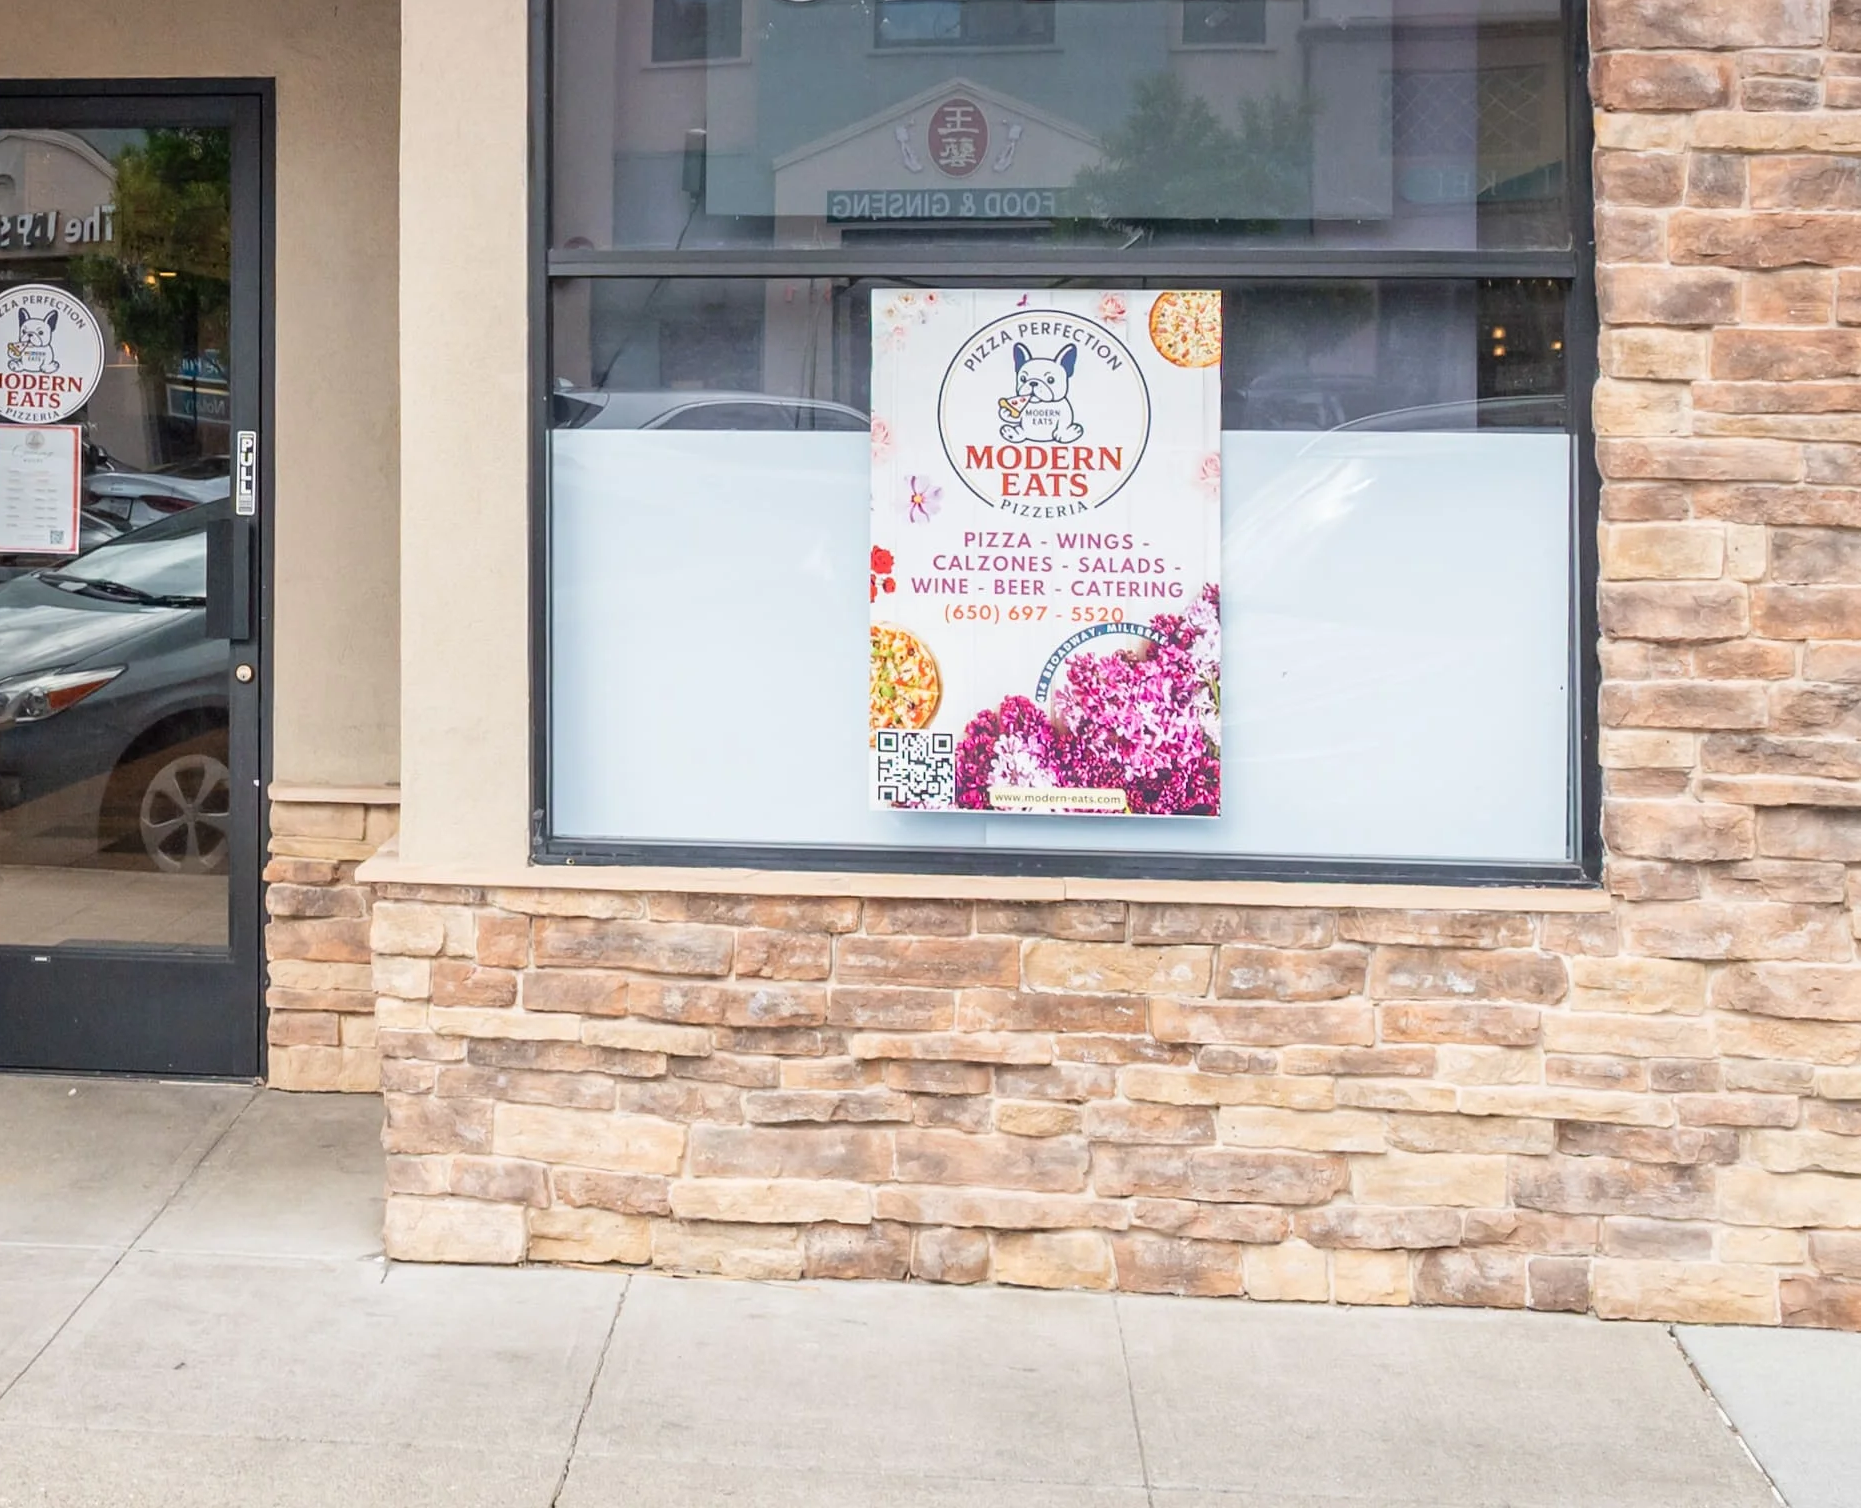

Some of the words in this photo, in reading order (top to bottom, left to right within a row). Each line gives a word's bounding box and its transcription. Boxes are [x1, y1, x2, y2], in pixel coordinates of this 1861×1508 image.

[22, 295, 87, 329] PERFECTION
[964, 330, 1012, 372] PIZZA
[1017, 322, 1123, 371] PERFECTION
[6, 391, 61, 409] EATS
[5, 407, 60, 422] PIZZERIA
[1025, 409, 1061, 417] MODERN
[1032, 418, 1053, 426] EATS
[240, 437, 253, 494] PULL
[965, 445, 1123, 471] MODERN
[1001, 473, 1089, 498] EATS
[1000, 499, 1089, 519] PIZZERIA
[964, 532, 1032, 548] PIZZA
[1056, 533, 1134, 550] WINGS
[933, 555, 1053, 572] CALZONES
[1078, 557, 1165, 574] SALADS
[911, 577, 969, 594] WINE
[993, 579, 1046, 596] BEER
[1071, 580, 1184, 598] CATERING
[944, 604, 1000, 624] (650)
[1008, 605, 1048, 621] 697
[1071, 606, 1124, 624] 5520
[1043, 628, 1101, 679] BROADWAY,
[994, 793, 1121, 804] www.modern-eats.com
